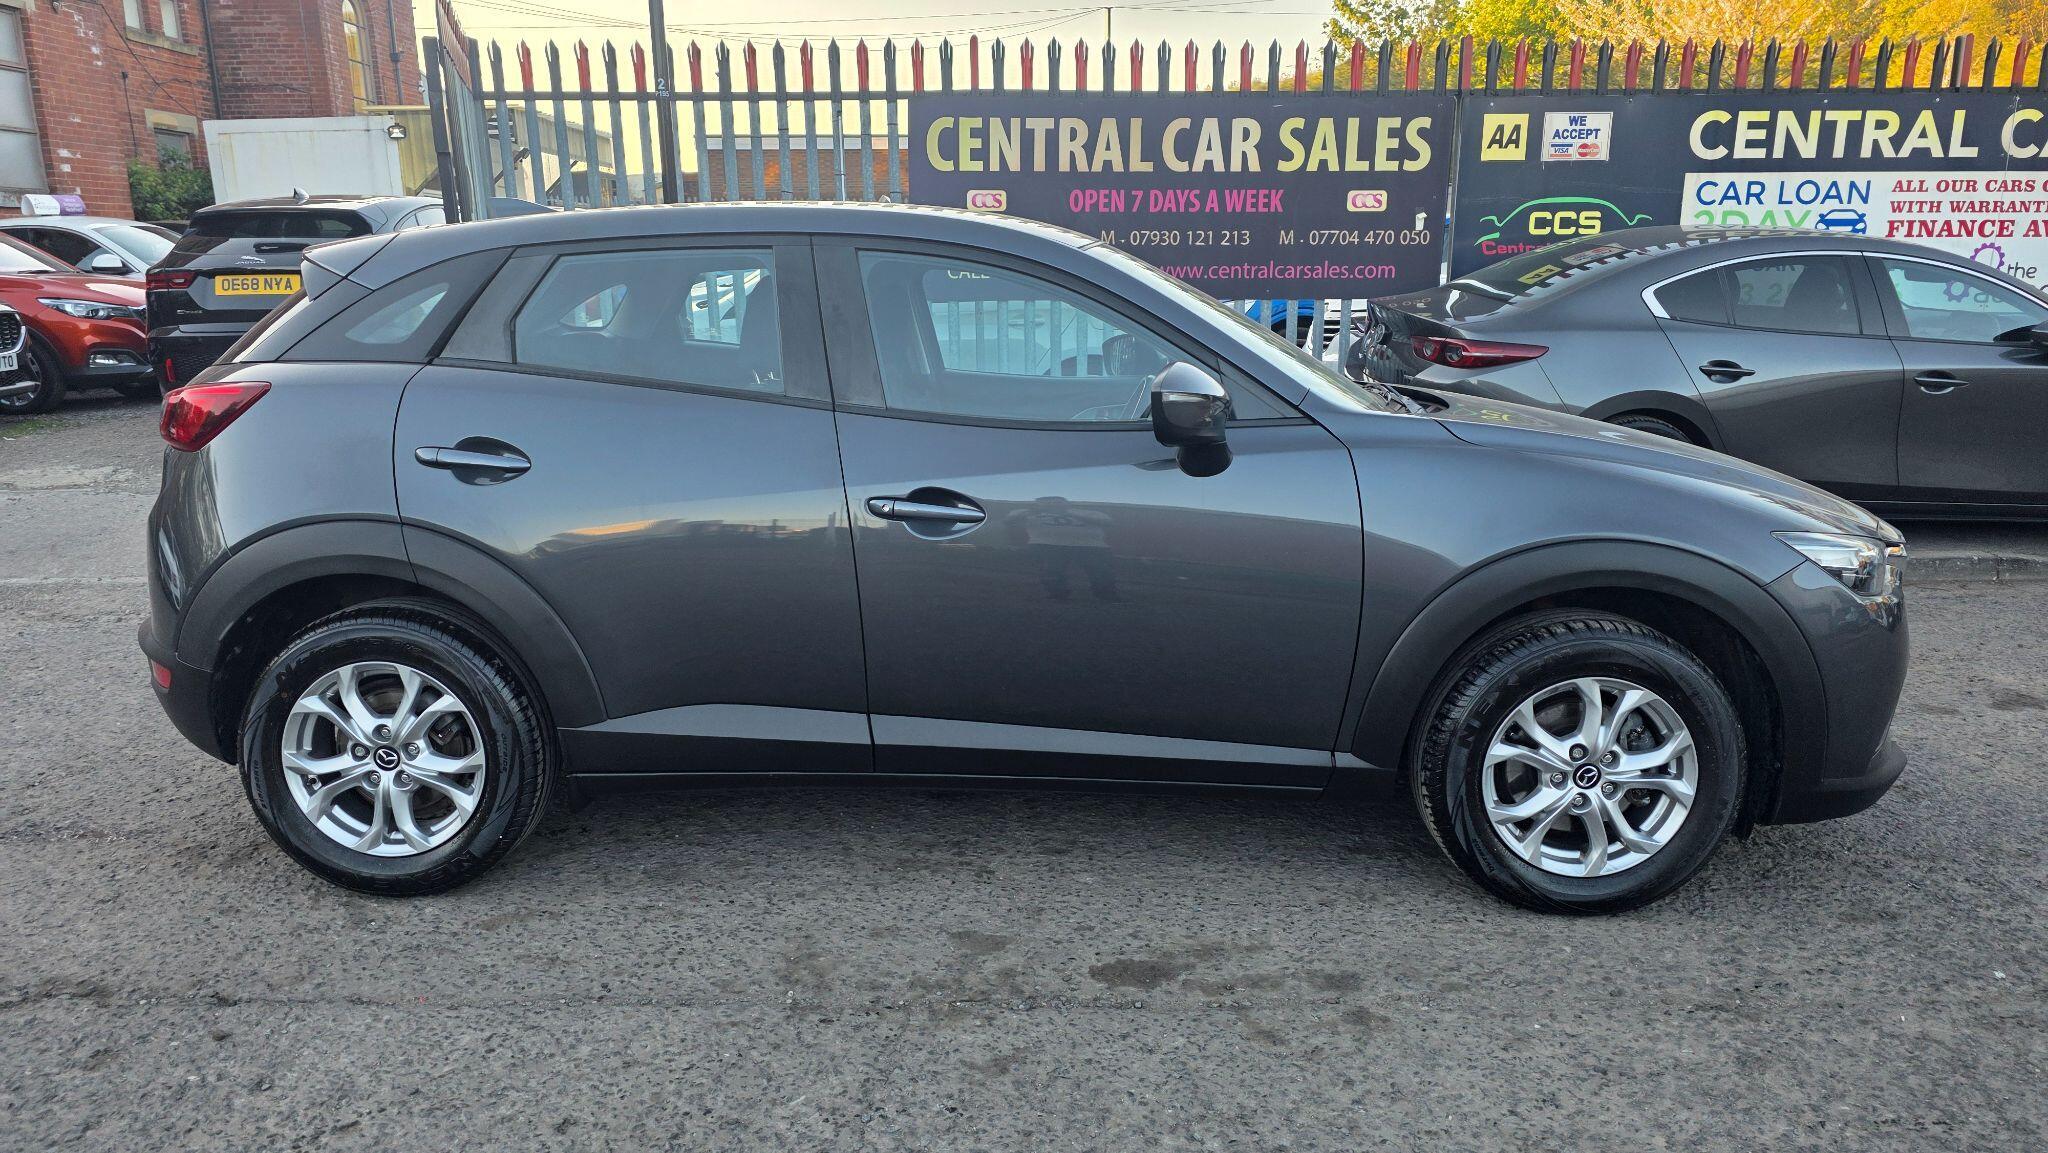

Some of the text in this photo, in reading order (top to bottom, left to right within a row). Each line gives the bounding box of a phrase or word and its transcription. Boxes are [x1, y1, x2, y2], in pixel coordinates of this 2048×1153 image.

[1568, 115, 1588, 127] WE
[1487, 123, 1522, 150] AA
[1552, 128, 1601, 140] ACCEPT
[1689, 108, 2048, 161] CENTRAL C
[926, 116, 1432, 172] CENTRAL CAR SALES
[1695, 179, 1872, 206] CAR LOAN
[1891, 179, 1930, 193] ALL
[1935, 179, 1979, 193] OUR
[1984, 179, 2037, 193] CARS
[1069, 189, 1285, 213] OPEN 7 DAYS A WEEK
[1889, 200, 2048, 214] WITH WARRANT
[1528, 210, 1603, 235] CCS
[1884, 219, 2016, 238] FINANCE
[1129, 230, 1181, 246] 07930
[1186, 230, 1214, 245] 121
[1220, 230, 1251, 246] 213
[1279, 229, 1295, 245] M
[1309, 230, 1360, 245] 07704
[1364, 230, 1395, 245] 470
[1400, 230, 1431, 245] 050
[1481, 240, 1550, 255] Centr
[2007, 261, 2038, 279] the
[221, 277, 294, 291] OE68 NYA
[0, 355, 14, 369] TO
